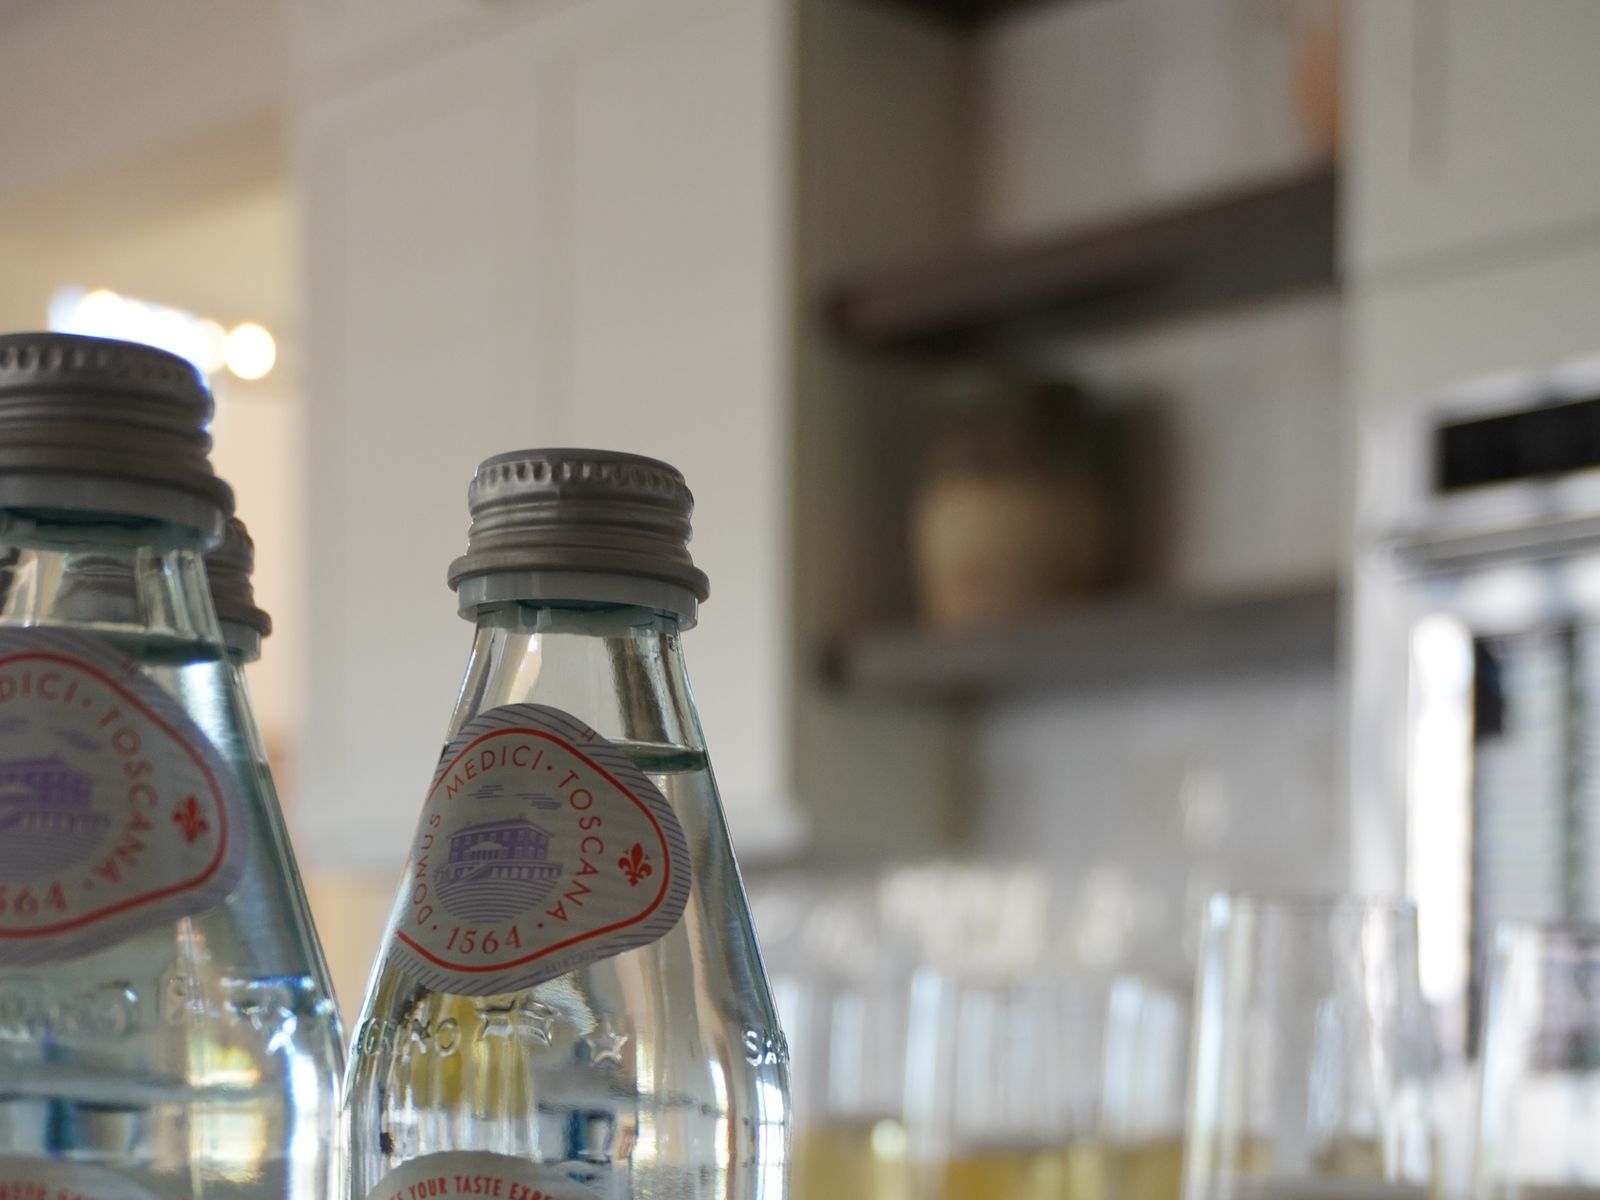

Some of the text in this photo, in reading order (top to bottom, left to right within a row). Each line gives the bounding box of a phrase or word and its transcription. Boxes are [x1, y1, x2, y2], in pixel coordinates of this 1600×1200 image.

[97, 706, 158, 883] TOSCANA
[446, 744, 544, 801] MEDICI
[413, 813, 442, 926] DOMUS
[545, 769, 605, 922] TOSCANA
[446, 924, 523, 955] 1564
[453, 1174, 502, 1198] TASTE
